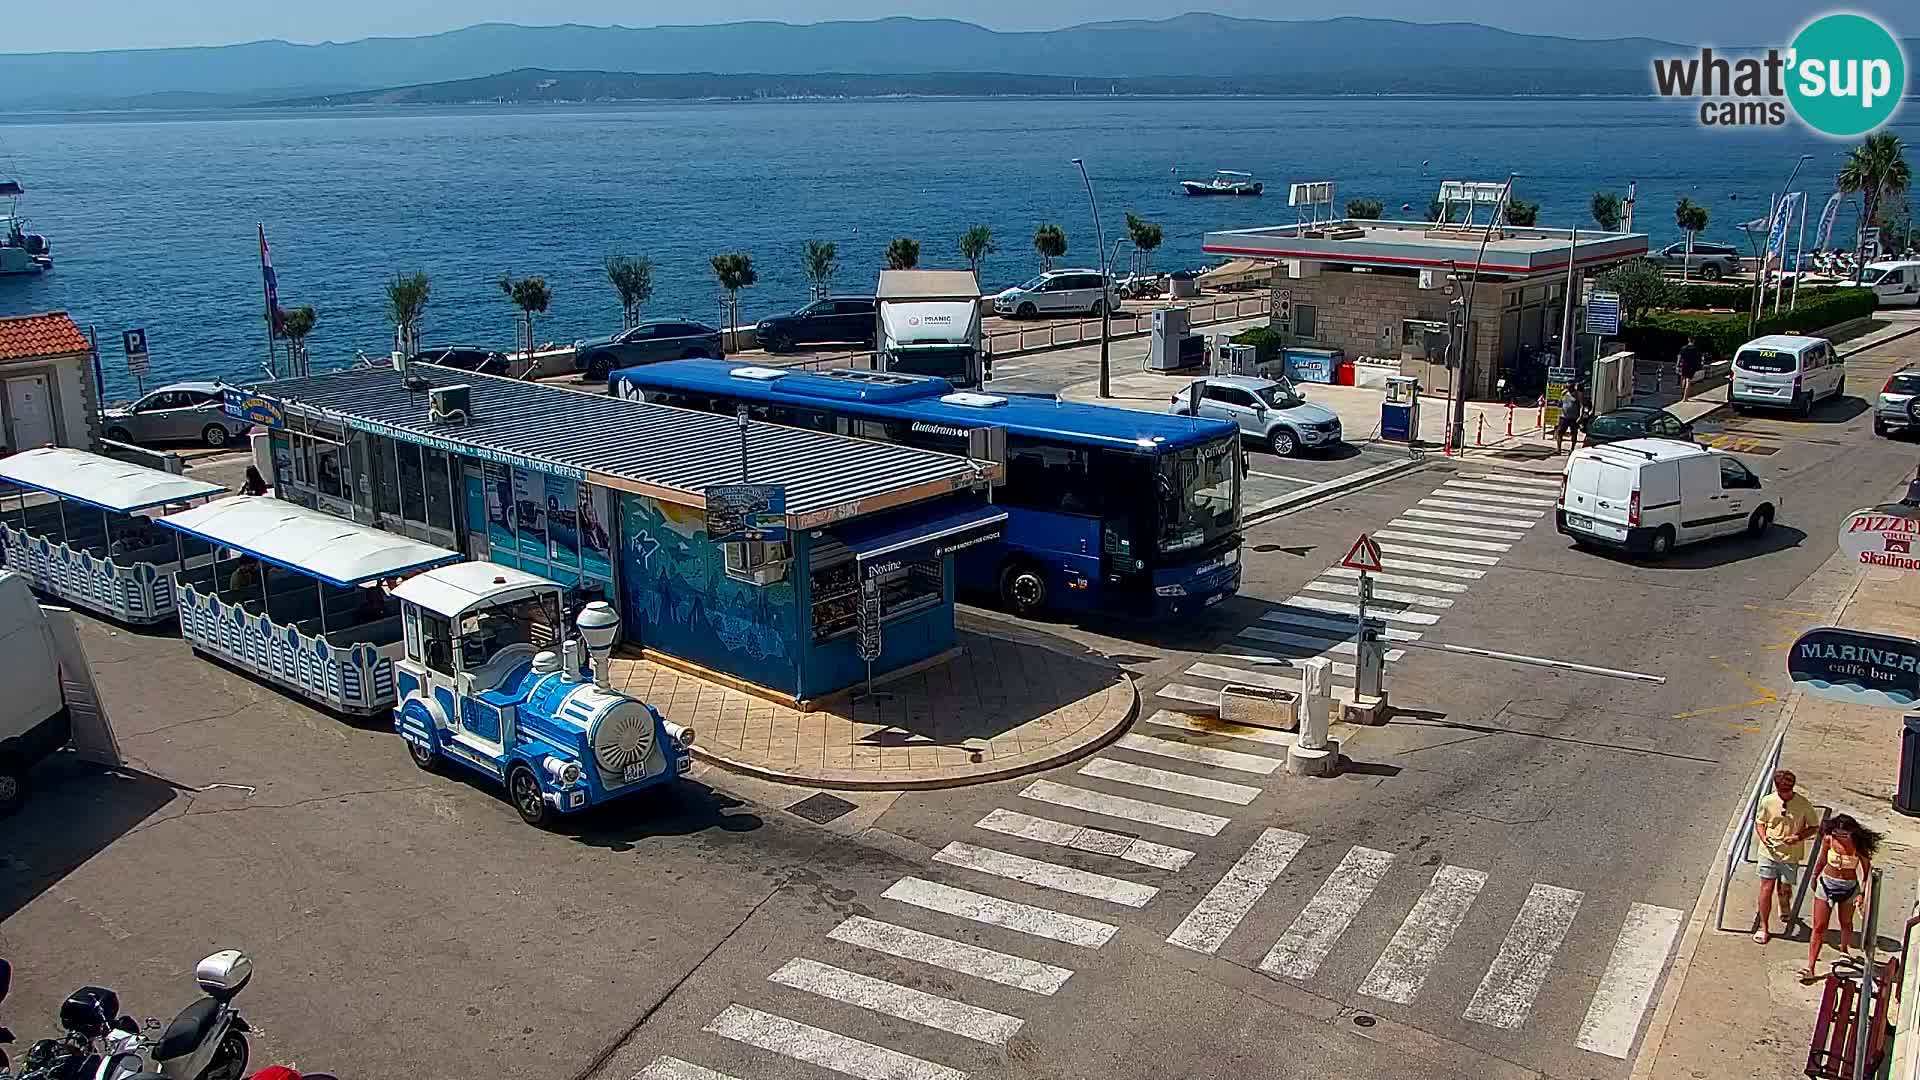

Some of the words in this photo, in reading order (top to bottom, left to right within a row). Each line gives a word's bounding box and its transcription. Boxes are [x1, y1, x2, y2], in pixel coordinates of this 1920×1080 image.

[129, 333, 141, 352] P
[435, 438, 467, 454] POSTAJA
[477, 447, 492, 460] BUS
[492, 450, 526, 468] STATION
[527, 458, 554, 473] TICKET
[553, 465, 582, 479] OFFICE
[1848, 517, 1920, 534] PIZZE
[1800, 643, 1920, 673] MARINER
[1828, 662, 1866, 677] caffe
[1870, 666, 1897, 681] bar
